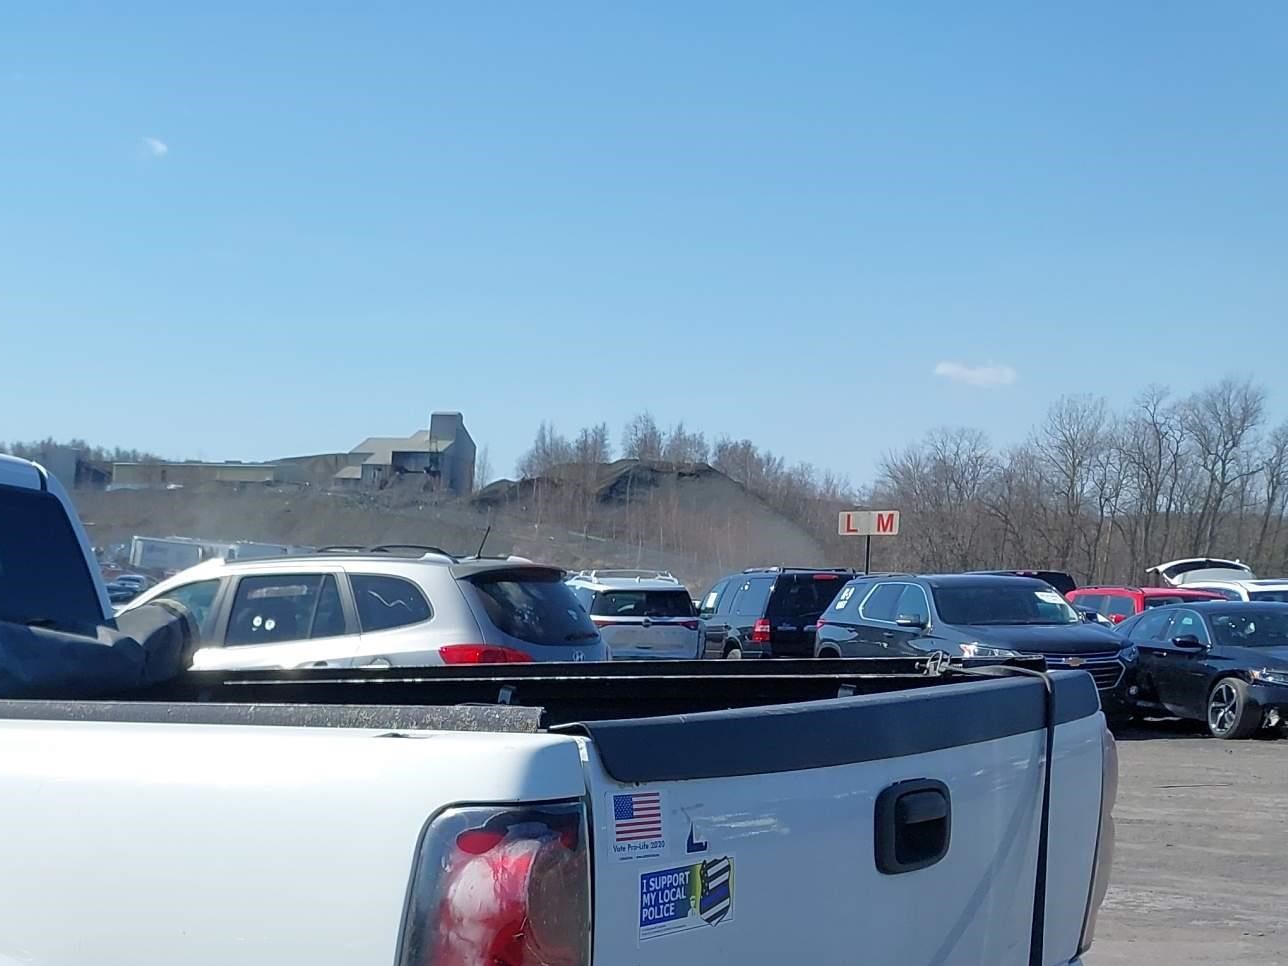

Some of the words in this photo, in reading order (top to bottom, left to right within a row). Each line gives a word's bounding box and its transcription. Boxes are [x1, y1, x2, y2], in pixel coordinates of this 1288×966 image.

[846, 513, 858, 533] L
[877, 513, 894, 532] M
[613, 844, 626, 853] Vote
[627, 841, 649, 852] Pro-Life
[642, 879, 647, 892] I
[649, 871, 690, 891] SUPPORT
[642, 892, 657, 907] MY
[659, 886, 686, 903] LOCAL
[642, 902, 675, 921] POLICE
